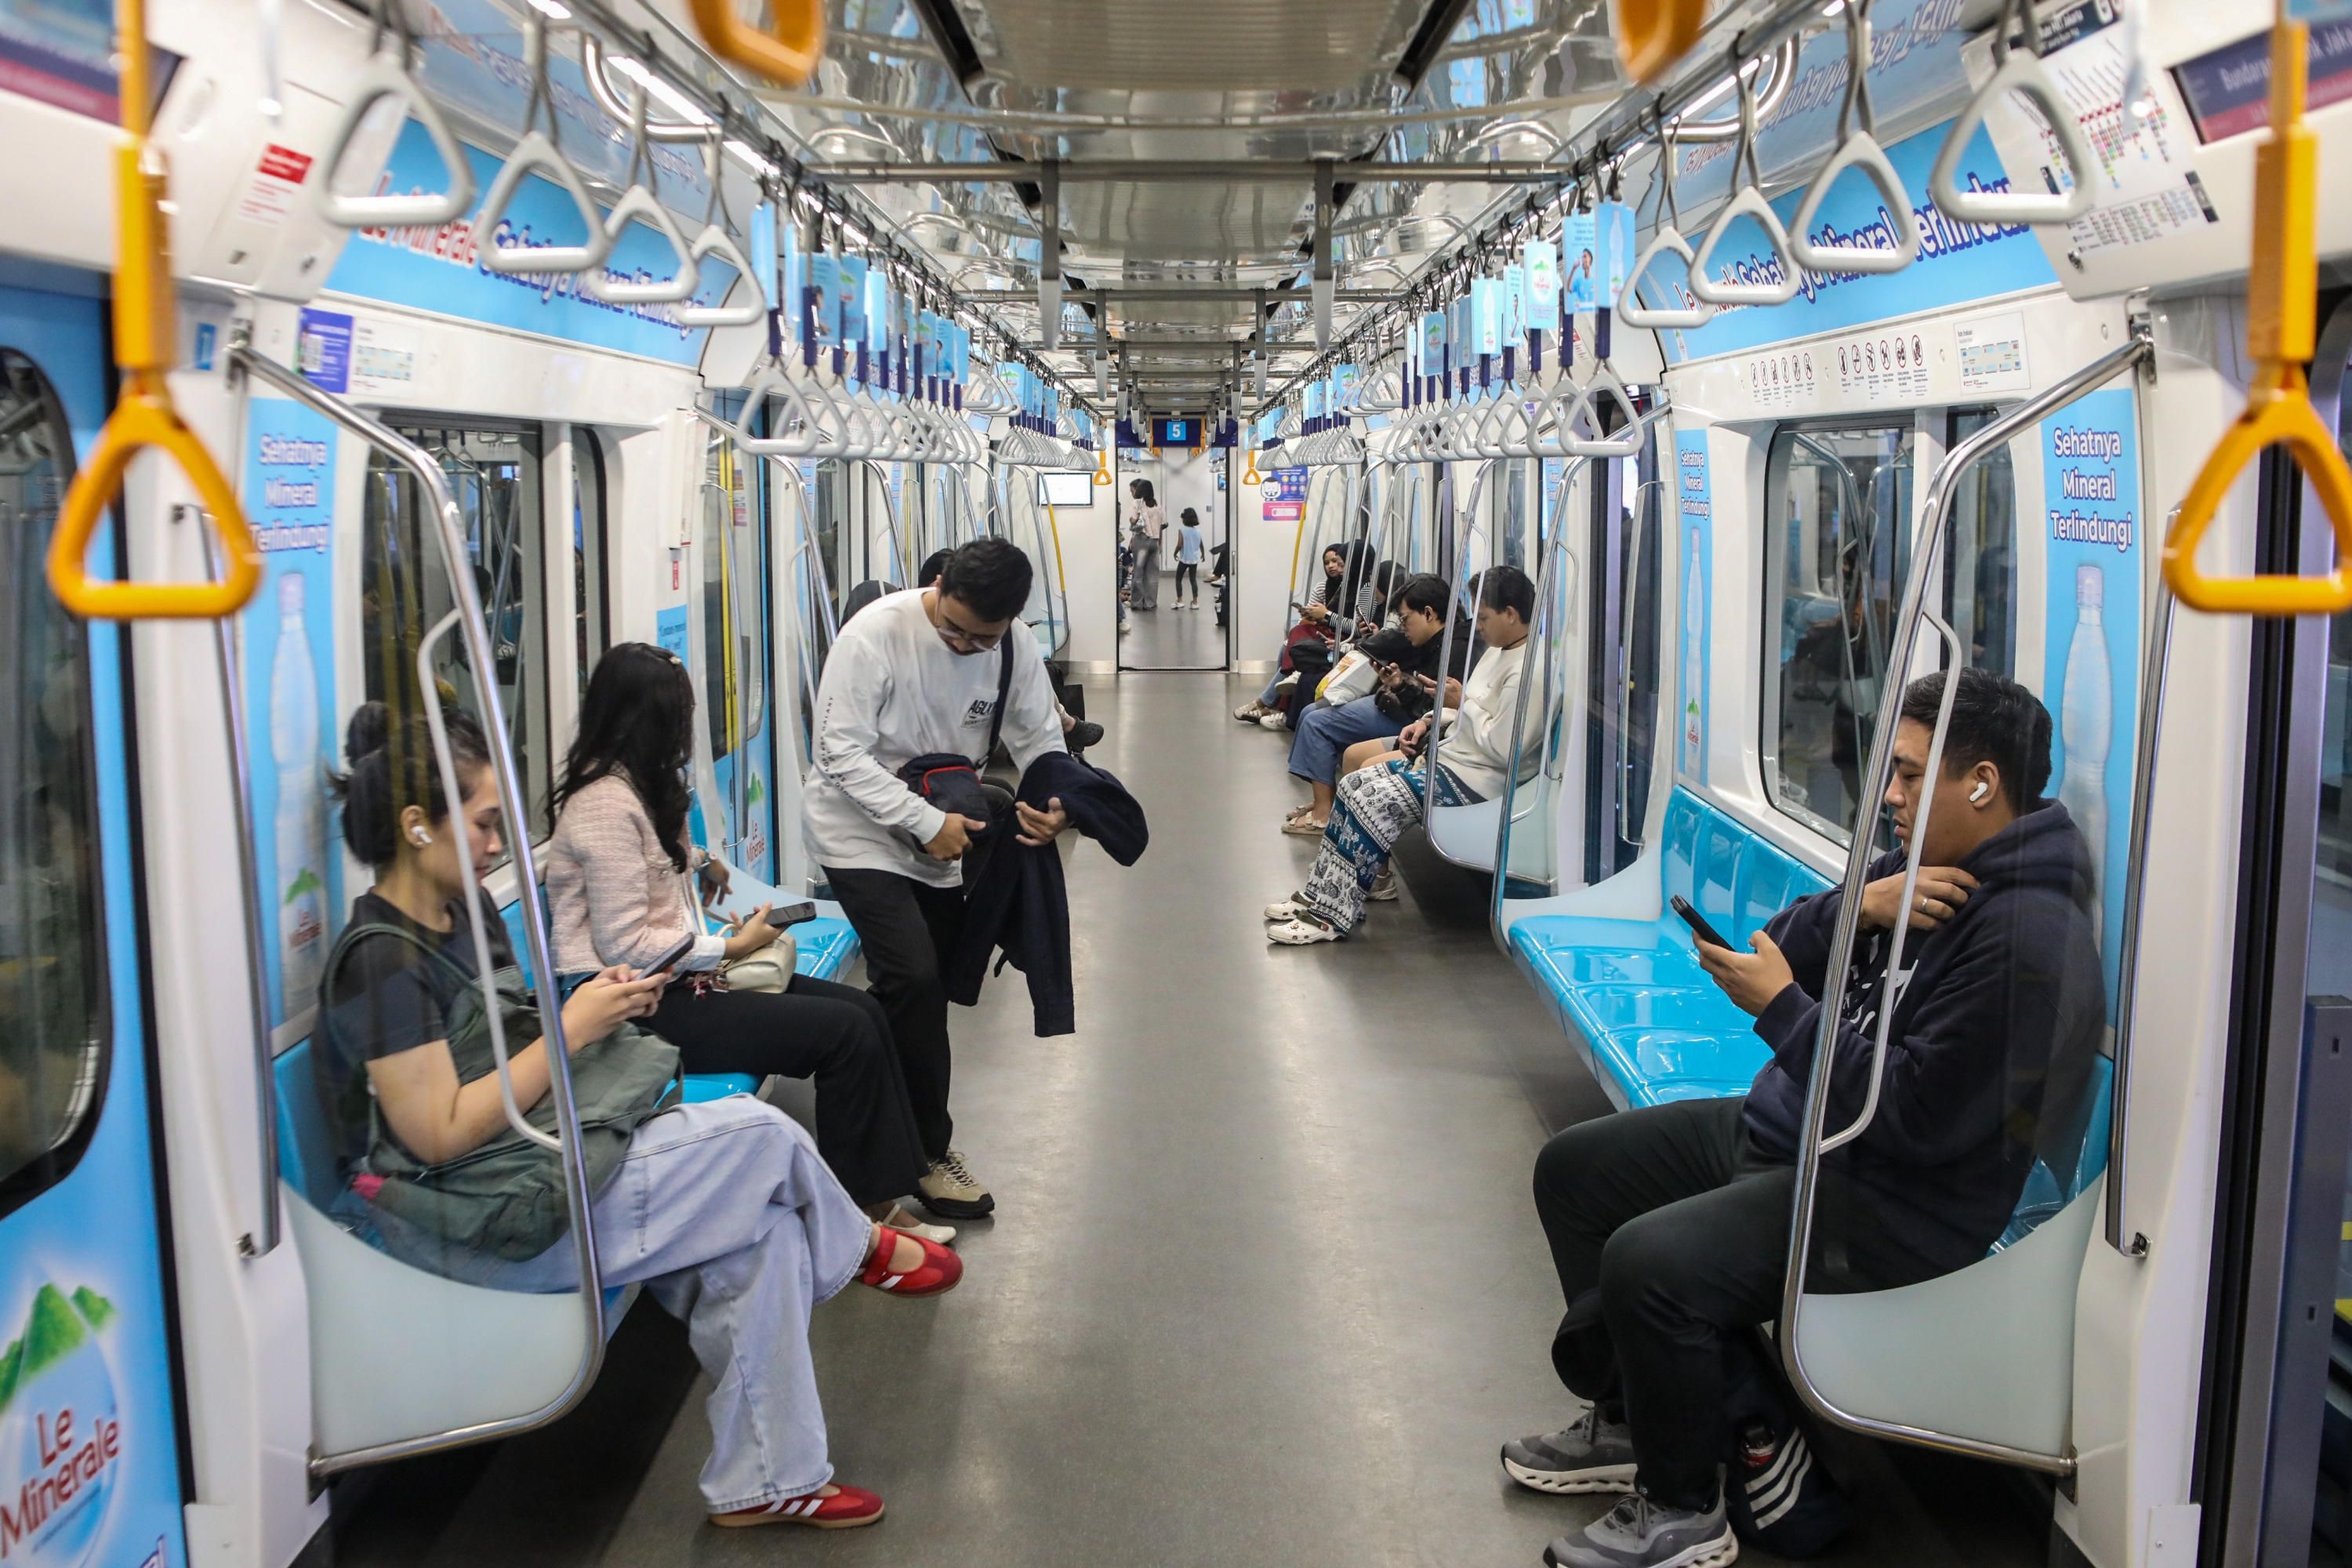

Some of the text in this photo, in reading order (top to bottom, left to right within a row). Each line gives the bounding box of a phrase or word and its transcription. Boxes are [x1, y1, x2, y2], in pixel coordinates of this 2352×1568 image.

[1172, 424, 1181, 437] 5
[2053, 426, 2122, 464] Sehatnya
[260, 433, 327, 472] Sehatnya
[1681, 448, 1704, 470] Sehatnya
[264, 474, 319, 509] Mineral
[1684, 472, 1704, 492] Mineral
[2062, 466, 2117, 501] Mineral
[1680, 495, 1710, 521] Terlindungi
[248, 514, 331, 555] Terlindungi
[2050, 509, 2133, 554] Terlindungi
[37, 1409, 73, 1469] Le
[0, 1417, 118, 1560] Minerale
